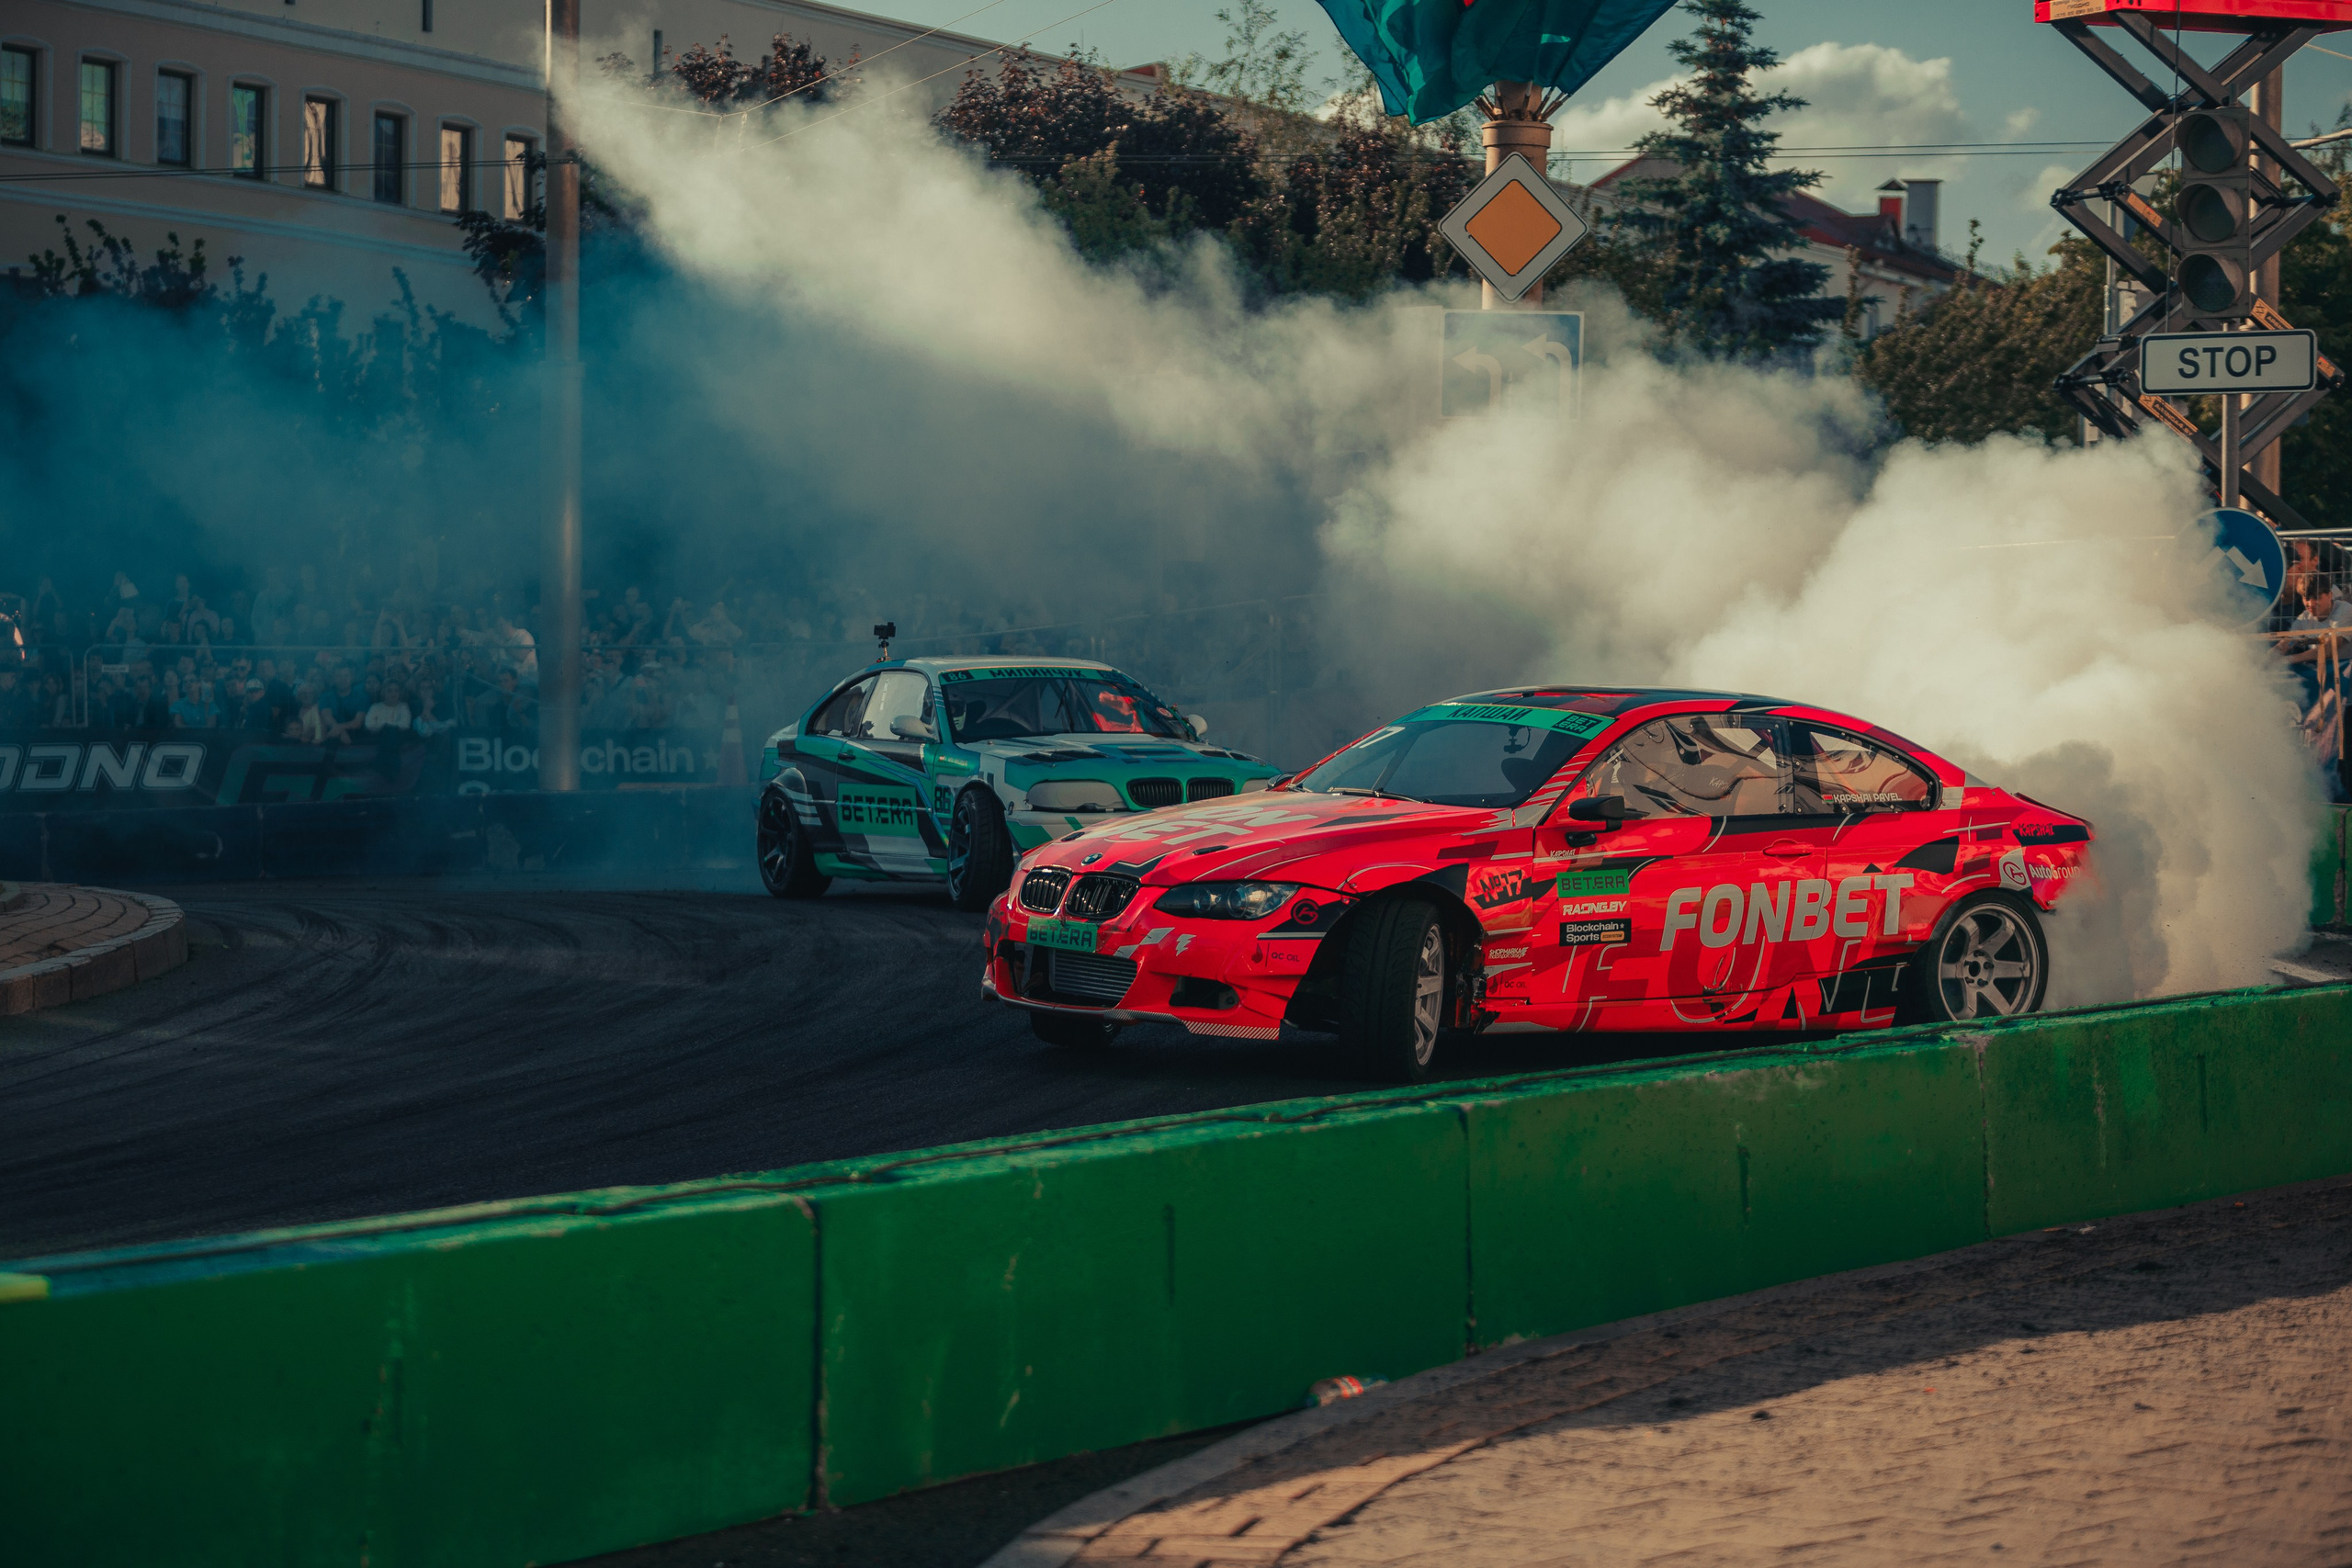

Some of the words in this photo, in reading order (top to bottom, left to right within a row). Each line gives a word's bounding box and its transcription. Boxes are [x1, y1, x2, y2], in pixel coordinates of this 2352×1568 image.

[2177, 345, 2277, 378] STOP
[1566, 715, 1597, 726] BET
[458, 737, 695, 773] Blochain
[934, 785, 952, 814] 86
[1834, 793, 1872, 803] KAPSHAI
[1873, 792, 1903, 802] PAVEL
[2029, 863, 2081, 881] AutoGroup
[1563, 900, 1627, 916] RACING.BY
[1659, 874, 1915, 952] FONBET
[1566, 922, 1619, 933] Blockchain
[1566, 932, 1600, 943] Sports
[1286, 953, 1300, 962] OIL
